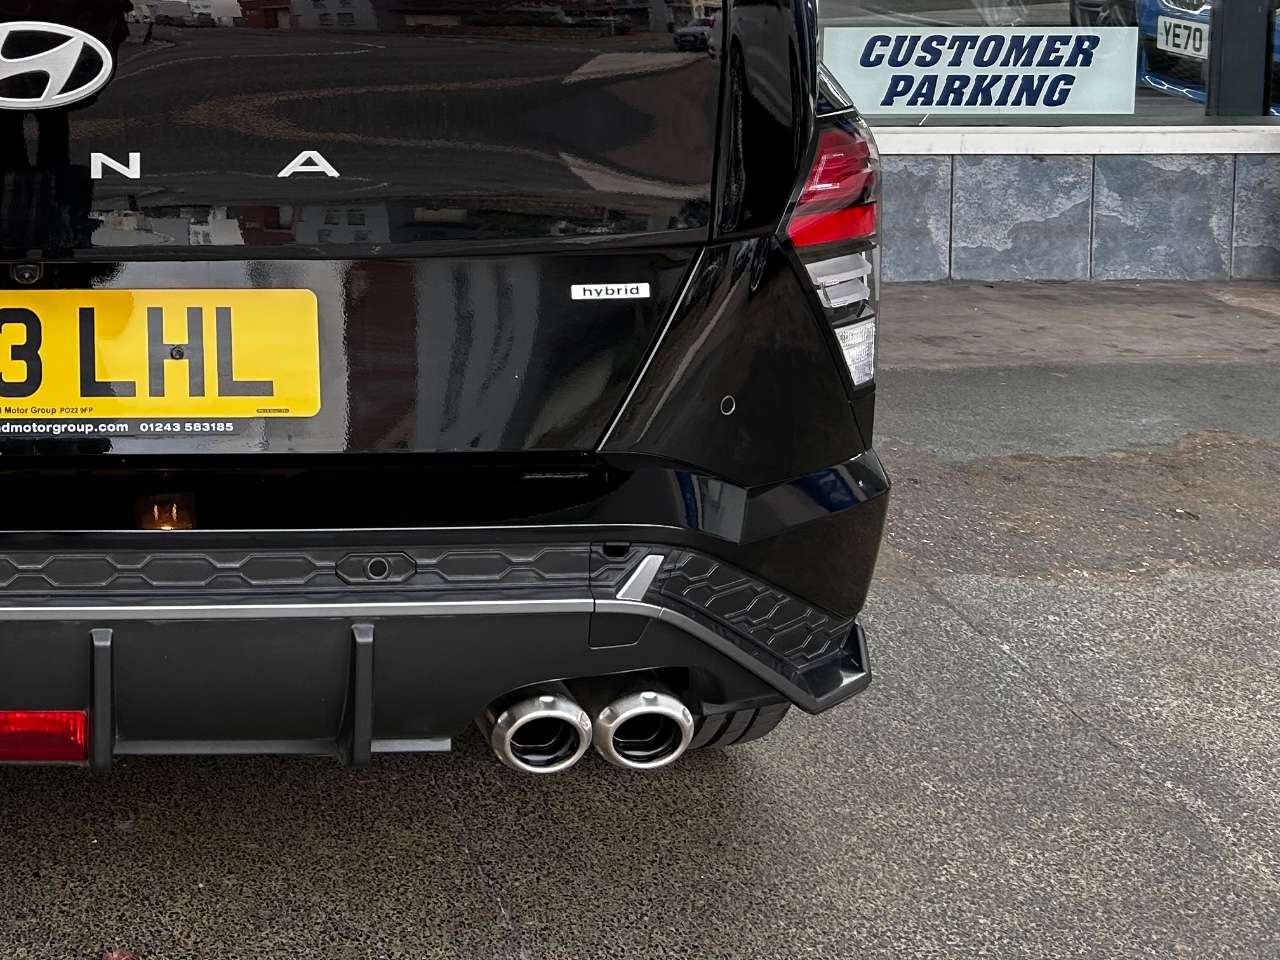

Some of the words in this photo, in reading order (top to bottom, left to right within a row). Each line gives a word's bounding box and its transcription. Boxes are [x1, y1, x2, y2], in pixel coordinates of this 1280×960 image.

[859, 34, 1101, 68] CUSTOMER
[1163, 20, 1203, 52] YE70
[880, 73, 1076, 108] PARKING
[583, 285, 640, 297] hybrid
[79, 306, 274, 398] LHL
[30, 406, 57, 416] Group
[140, 422, 180, 432] 01243
[184, 422, 234, 432] 583185
